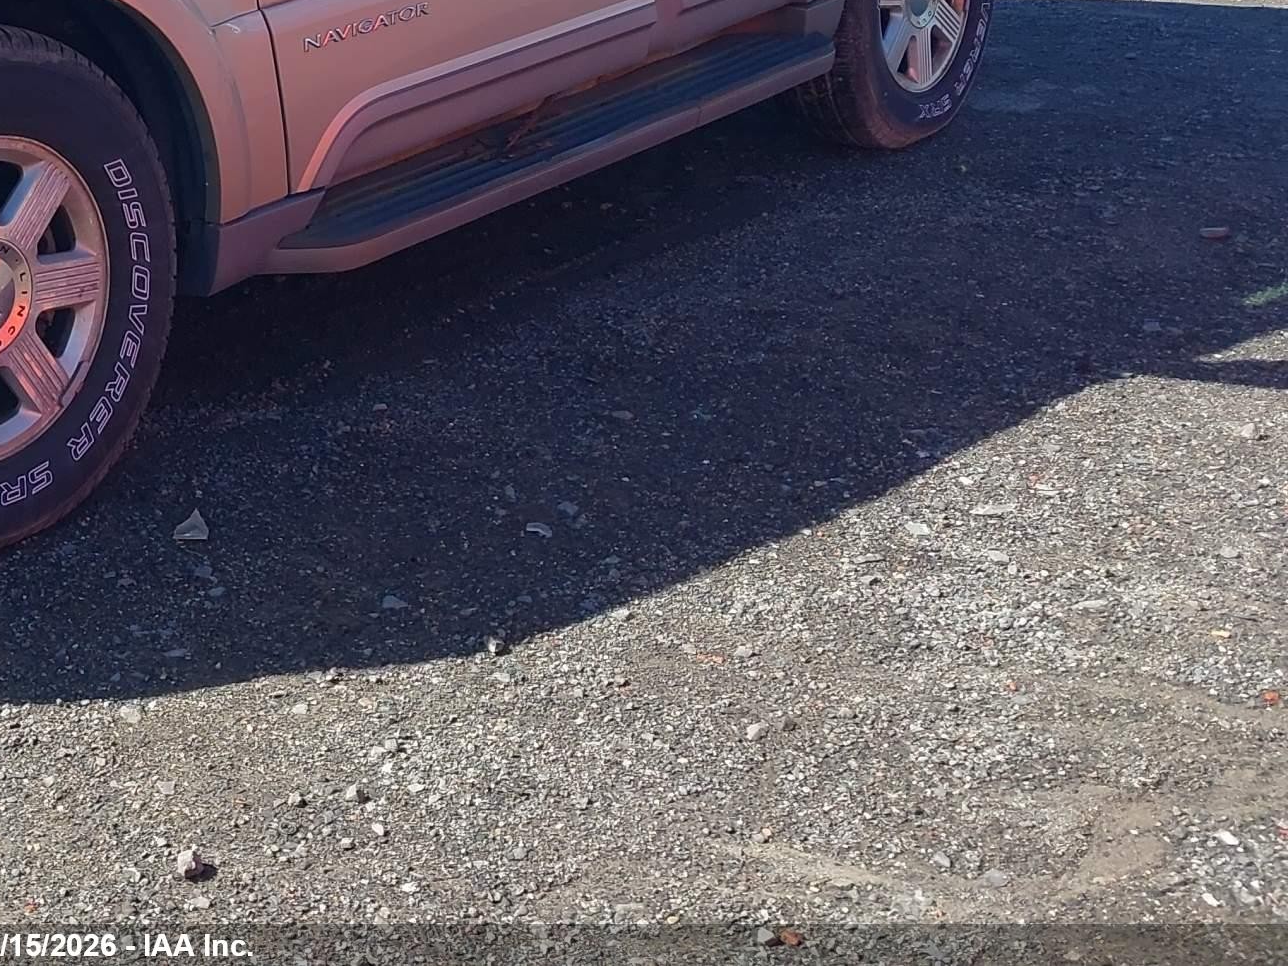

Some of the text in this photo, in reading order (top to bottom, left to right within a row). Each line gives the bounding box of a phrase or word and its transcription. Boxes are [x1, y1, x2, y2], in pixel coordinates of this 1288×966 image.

[302, 1, 430, 53] NAVIGATOR
[918, 93, 953, 120] SRX
[65, 157, 152, 462] DISCOVERER
